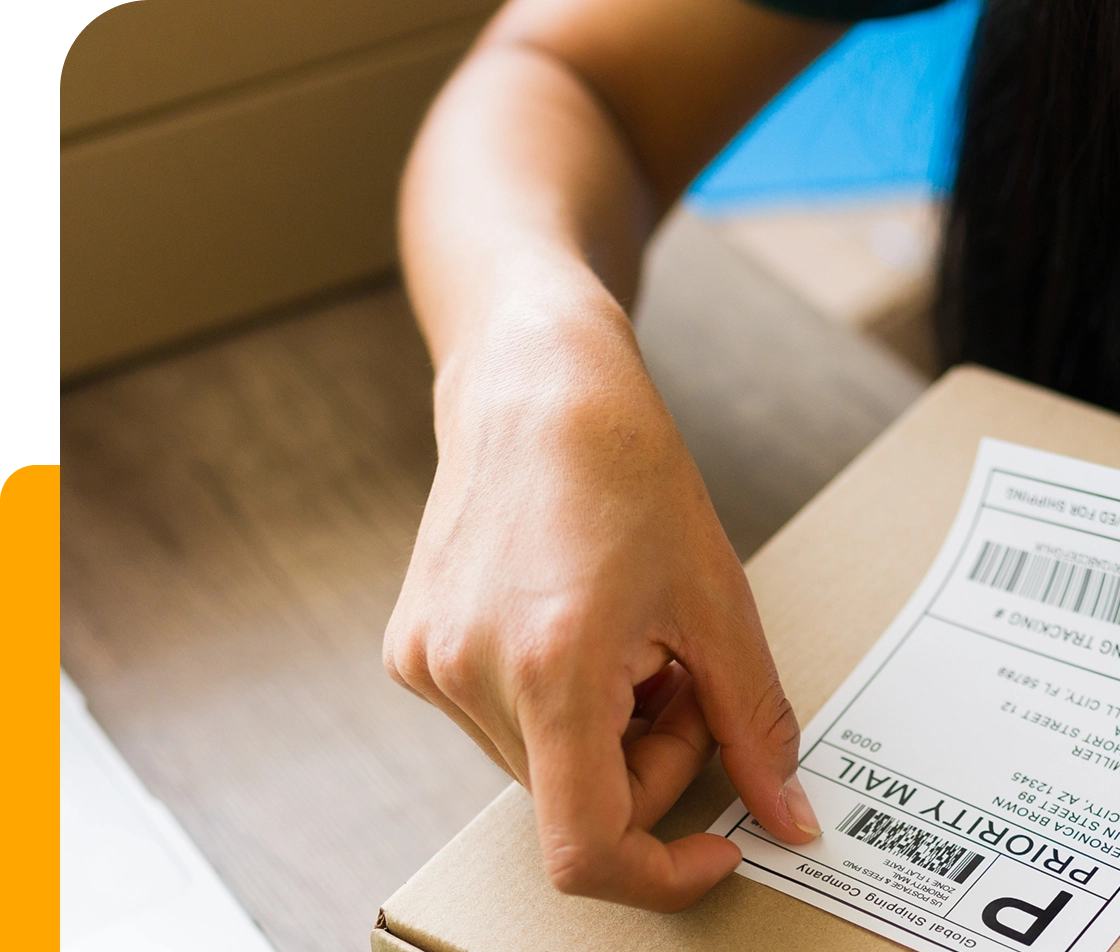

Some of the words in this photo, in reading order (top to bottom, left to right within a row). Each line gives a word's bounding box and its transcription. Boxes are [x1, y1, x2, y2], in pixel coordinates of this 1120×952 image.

[1005, 487, 1065, 512] SHIPPING
[1069, 502, 1096, 521] FOR
[1008, 610, 1095, 646] TRACKING
[997, 667, 1038, 689] 56789
[1044, 682, 1058, 696] FL
[1001, 701, 1017, 713] 12
[1066, 687, 1100, 711] CITY,
[1021, 709, 1080, 738] STREET
[841, 730, 882, 753] 0008
[838, 756, 917, 806] MAIL
[1011, 772, 1053, 795] 12345
[1018, 791, 1036, 804] 89
[1058, 791, 1080, 805] AZ
[992, 796, 1050, 826] BROWN
[1038, 801, 1100, 831] STREET
[1084, 800, 1120, 823] CITY,
[920, 800, 1099, 885] PRIORITY
[843, 860, 862, 872] PAID
[862, 869, 884, 881] FEES
[883, 859, 905, 872] RATE
[906, 871, 925, 882] FLAT
[796, 863, 861, 897] Company
[893, 872, 911, 884] MAIL
[931, 880, 956, 894] ZONE
[891, 882, 930, 901] POSTAGE
[910, 881, 950, 900] PRIORITY
[865, 893, 926, 926] Shipping
[930, 899, 943, 907] US
[982, 890, 1073, 946] P
[929, 923, 976, 948] Global
